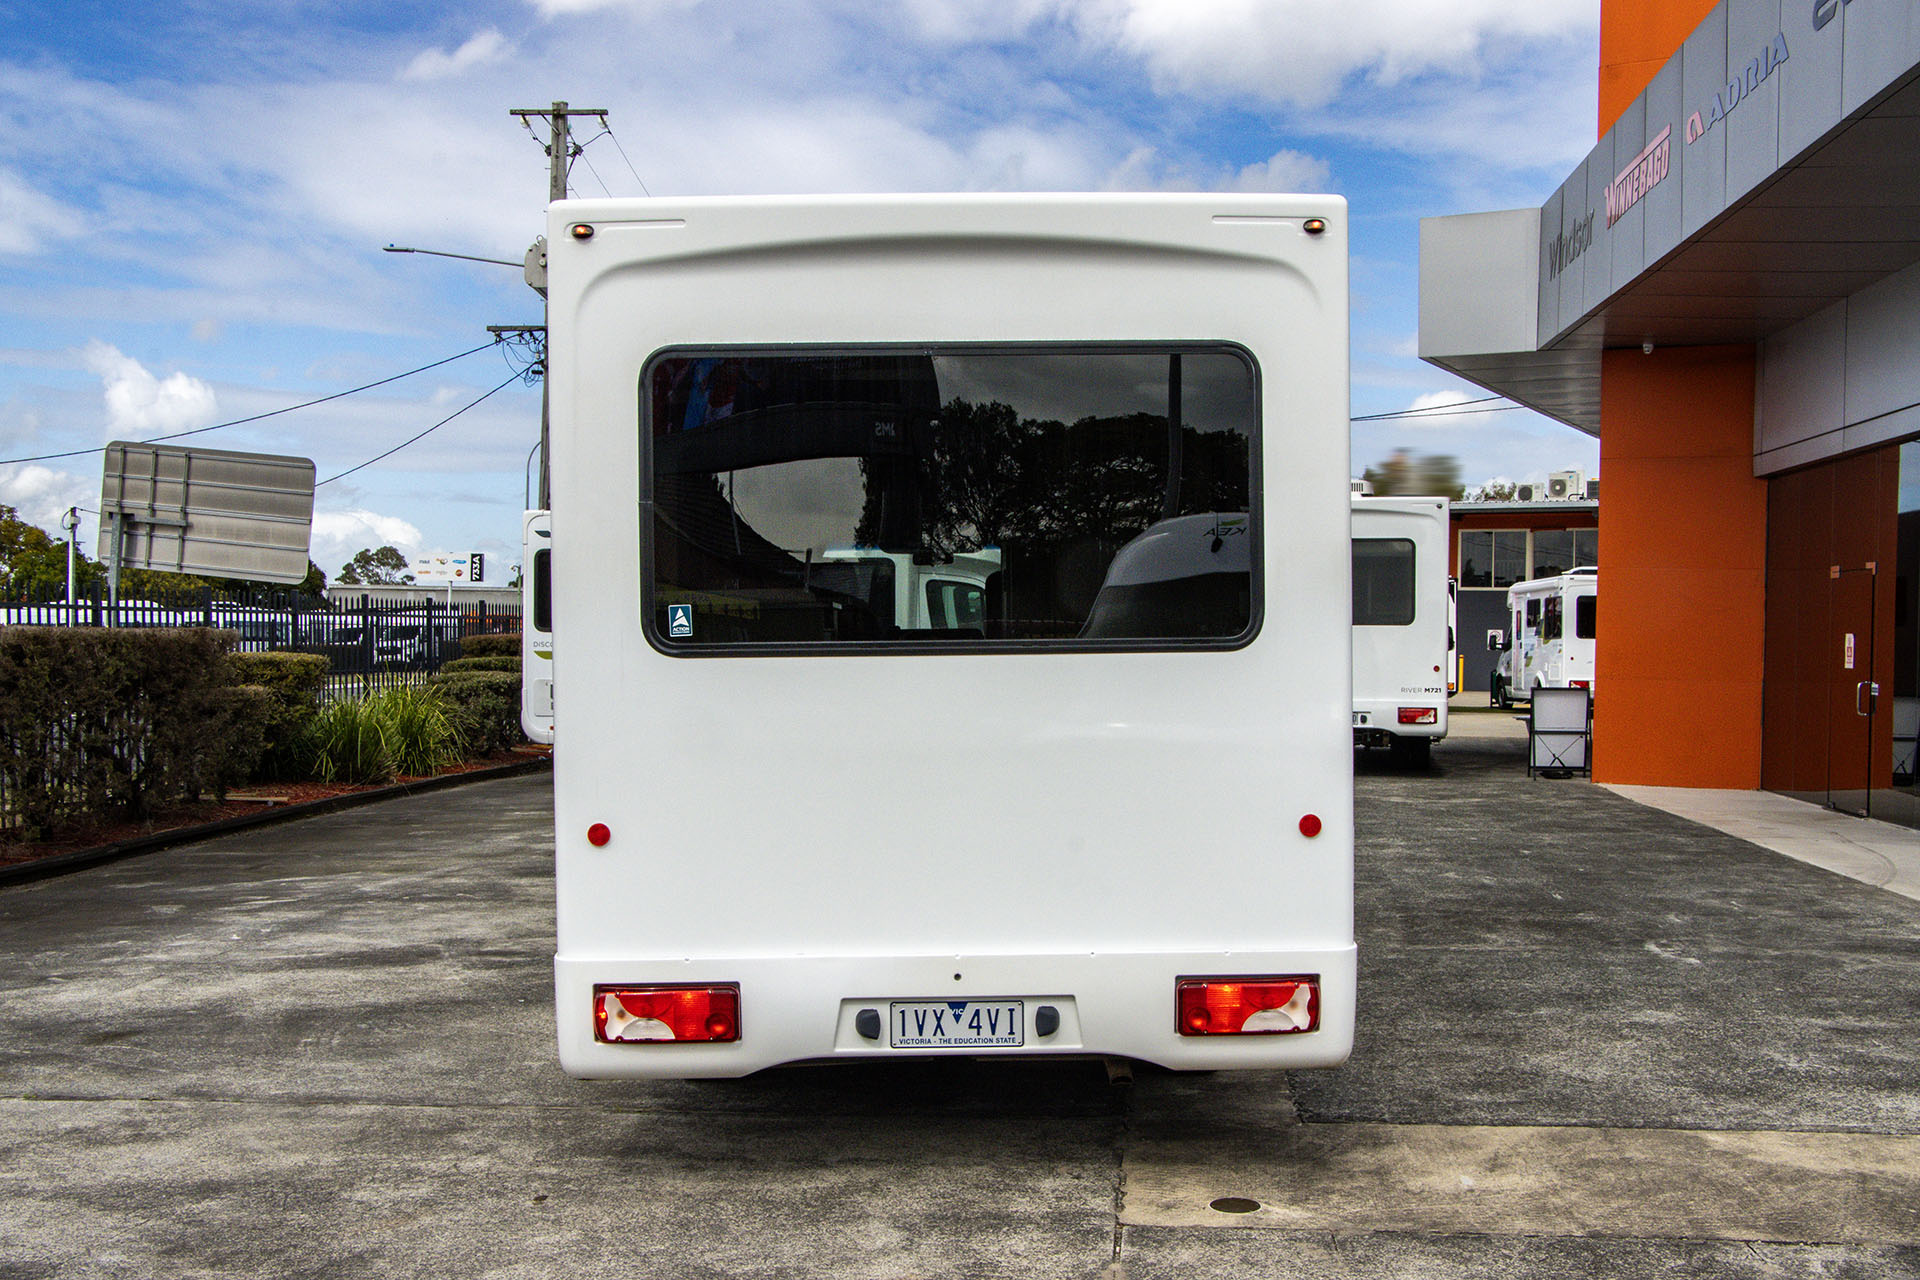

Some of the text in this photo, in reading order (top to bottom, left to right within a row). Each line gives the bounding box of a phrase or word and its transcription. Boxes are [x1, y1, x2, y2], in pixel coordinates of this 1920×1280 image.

[1707, 32, 1789, 131] ADRIA
[1604, 136, 1671, 230] WINNEBAGO
[1549, 208, 1594, 281] Windsor
[472, 555, 481, 581] 733A
[899, 1008, 946, 1037] 1VX
